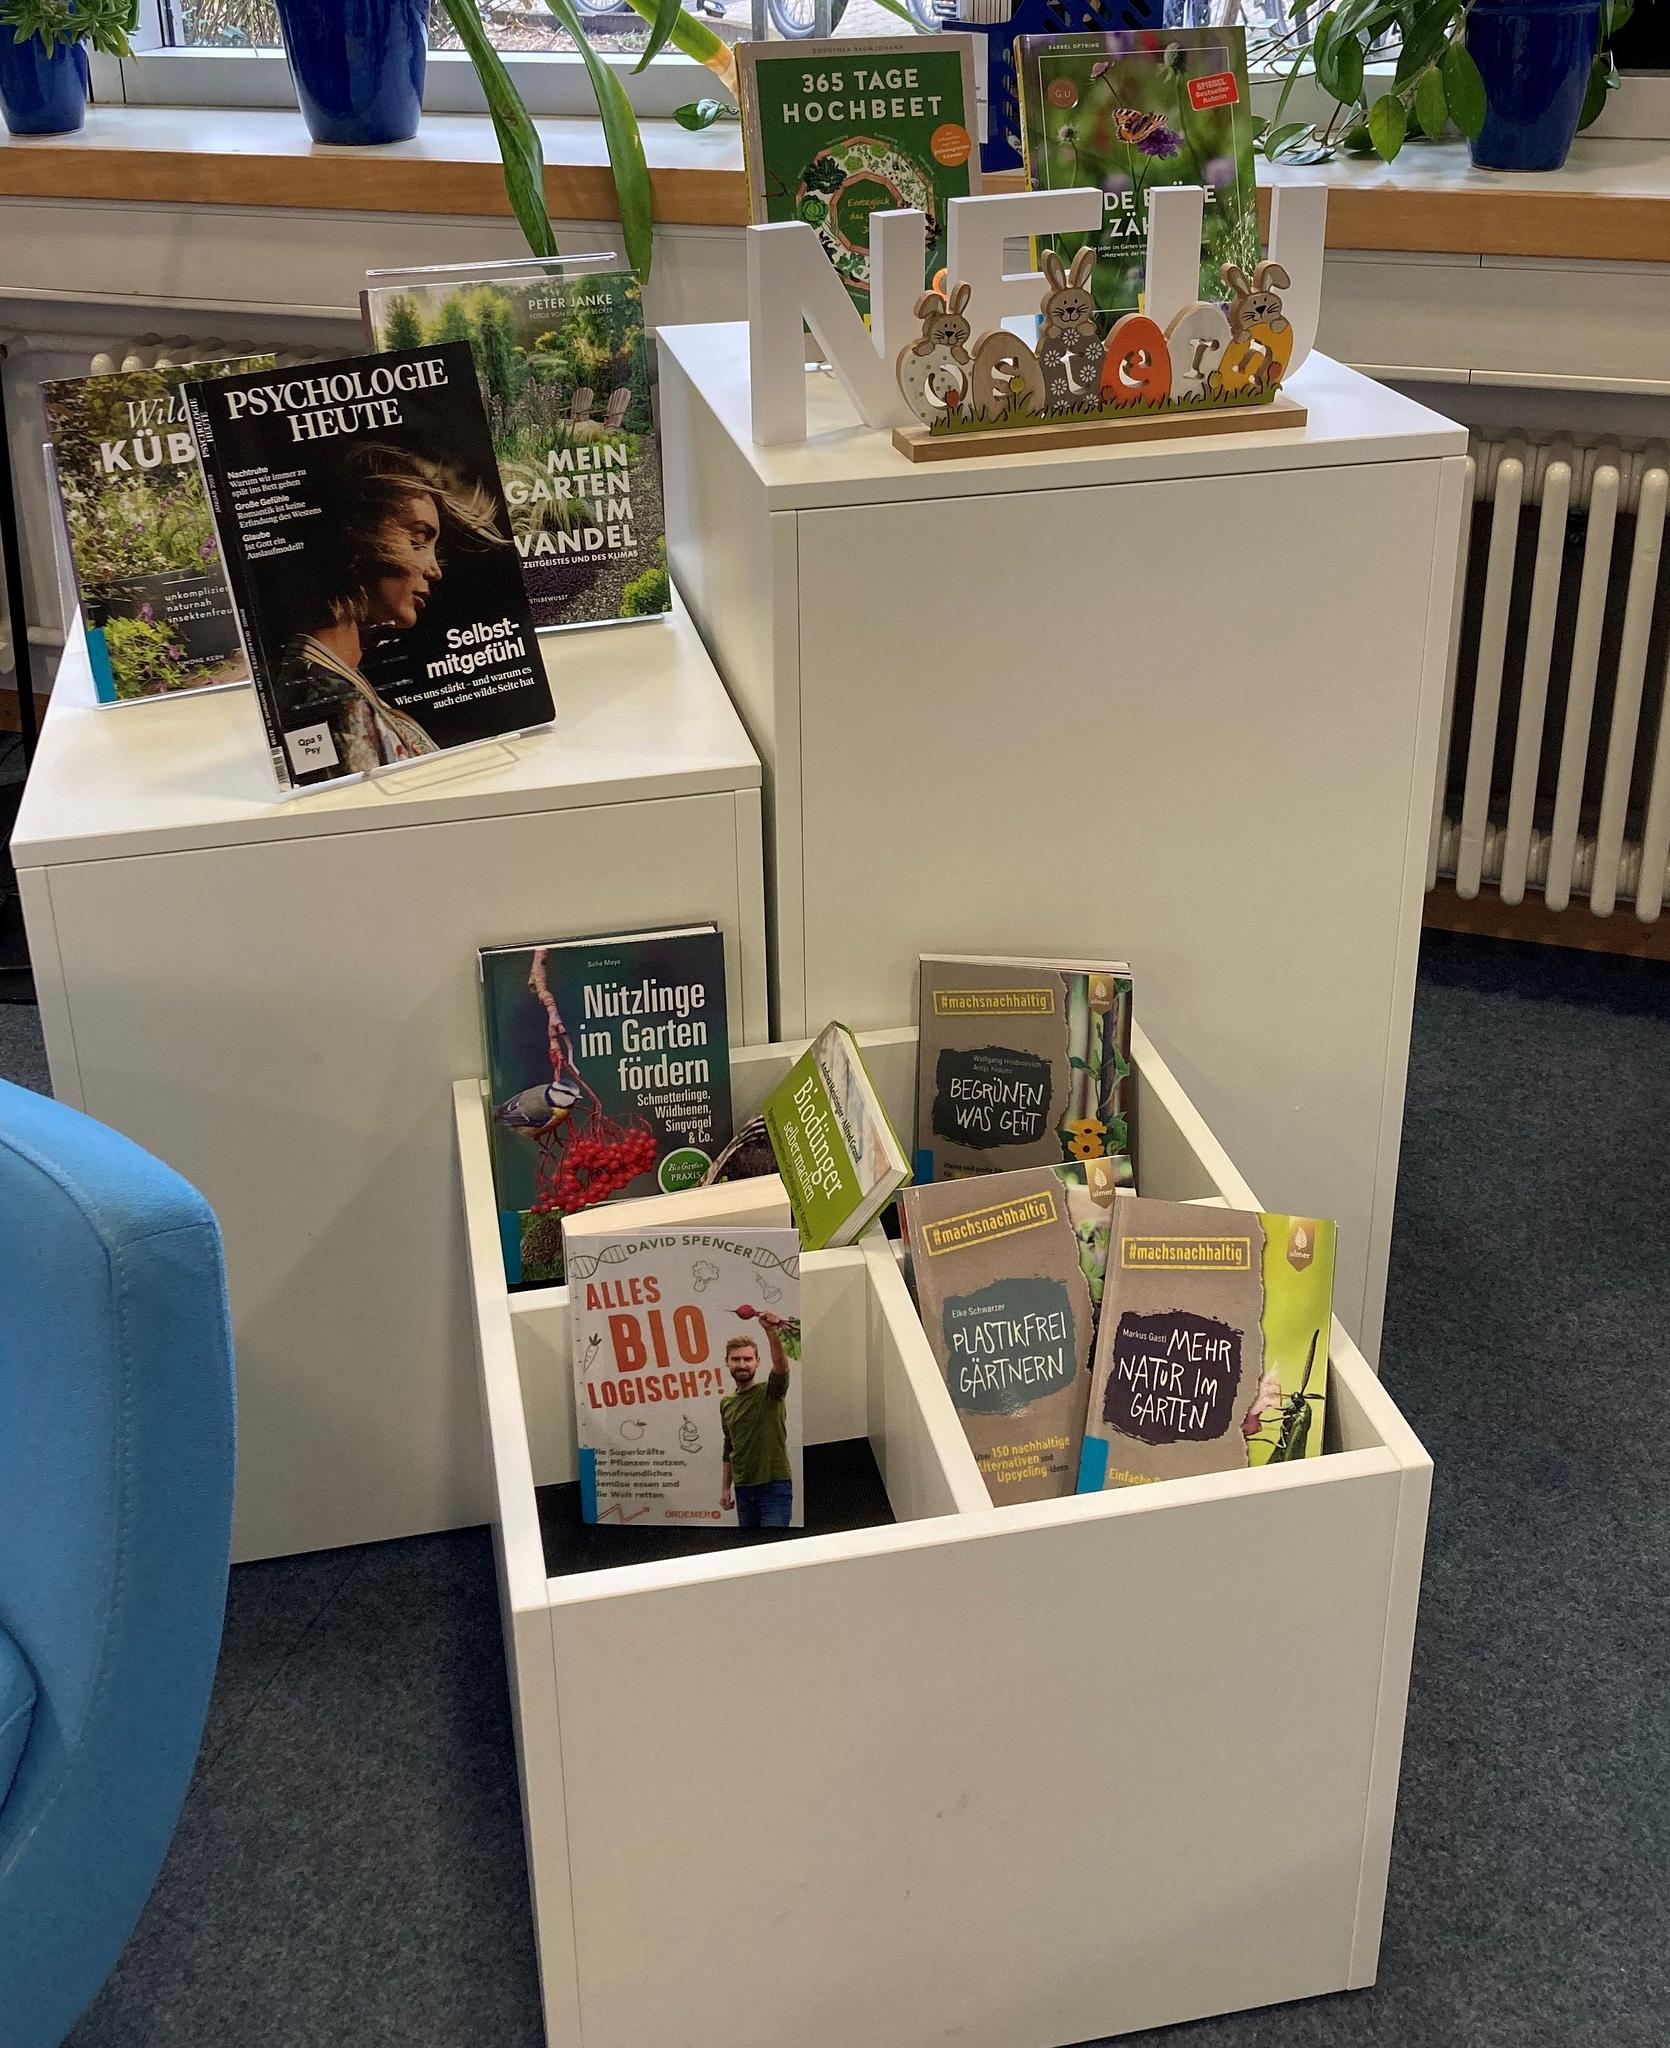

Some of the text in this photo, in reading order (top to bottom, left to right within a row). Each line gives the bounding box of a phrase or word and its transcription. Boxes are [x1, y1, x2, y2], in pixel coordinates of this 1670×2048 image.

[802, 68, 919, 94] 365 TAGE
[782, 95, 942, 124] HOCHBEET
[528, 294, 613, 310] PETER JANKE
[747, 182, 1327, 447] NEU
[224, 358, 449, 420] PSYCHOLOGIE
[287, 398, 403, 442] HEUTE
[100, 428, 198, 474] KÜB
[547, 444, 628, 475] MEIN
[227, 467, 269, 480] Nachtruhe
[229, 478, 258, 488] Warum
[272, 471, 296, 480] immer
[278, 479, 301, 490] gehen
[504, 471, 631, 505] GARTEN
[234, 495, 290, 511] Große Gefühle
[237, 506, 275, 520] Romantik
[285, 502, 306, 511] keine
[596, 498, 634, 523] IM
[239, 515, 278, 529] Erfindung
[291, 507, 322, 518] Westens
[242, 531, 271, 542] Glaube
[522, 550, 639, 569] ZEITGEISTES UND DES KLIMAS
[167, 599, 212, 612] naturnah
[168, 608, 233, 623] insektenfreu
[446, 617, 520, 649] Selbst-
[426, 636, 526, 679] mitgefühl
[394, 666, 532, 707] Wie es uns stärkt und warum es
[433, 676, 535, 710] auch eine wilde Seite hat
[583, 979, 705, 1019] Nützlinge
[941, 994, 1047, 1010] #machsnachhaltig
[580, 1019, 708, 1058] im Garten
[617, 1054, 710, 1092] fördern
[637, 1088, 711, 1106] Schmetterlinge,
[950, 1076, 1044, 1110] BEGRÜNEN
[655, 1104, 712, 1119] Wildbienen,
[665, 1115, 712, 1133] Singvögel
[956, 1105, 1041, 1136] WAS GEHT
[688, 1130, 714, 1144] & Co.
[793, 1076, 843, 1201] Biodünger
[783, 1121, 816, 1204] selber machen
[671, 1171, 701, 1181] PRAXIS
[1091, 1188, 1114, 1199] ulmer
[933, 1199, 1048, 1246] #machsnachhaltig
[626, 1235, 752, 1259] DAVID SPENCER
[1129, 1243, 1242, 1265] #machsnachhaltig
[1290, 1250, 1311, 1259] ulmer
[586, 1276, 661, 1312] ALLES
[968, 1303, 1005, 1316] Schwarzer
[608, 1304, 710, 1373] BIO
[952, 1311, 1067, 1355] PLASTIKFREI
[1122, 1328, 1167, 1343] Markus Gastl
[1167, 1328, 1232, 1373] MEHR
[960, 1347, 1064, 1398] GÄRTNERN
[587, 1367, 725, 1409] LOGISCH?!
[1194, 1368, 1218, 1407] IM
[1130, 1393, 1208, 1433] GARTEN
[609, 1448, 665, 1457] Superkräfte
[992, 1436, 1071, 1459] 150 nachhaltige
[653, 1460, 688, 1468] nutzen,
[662, 1480, 680, 1488] und
